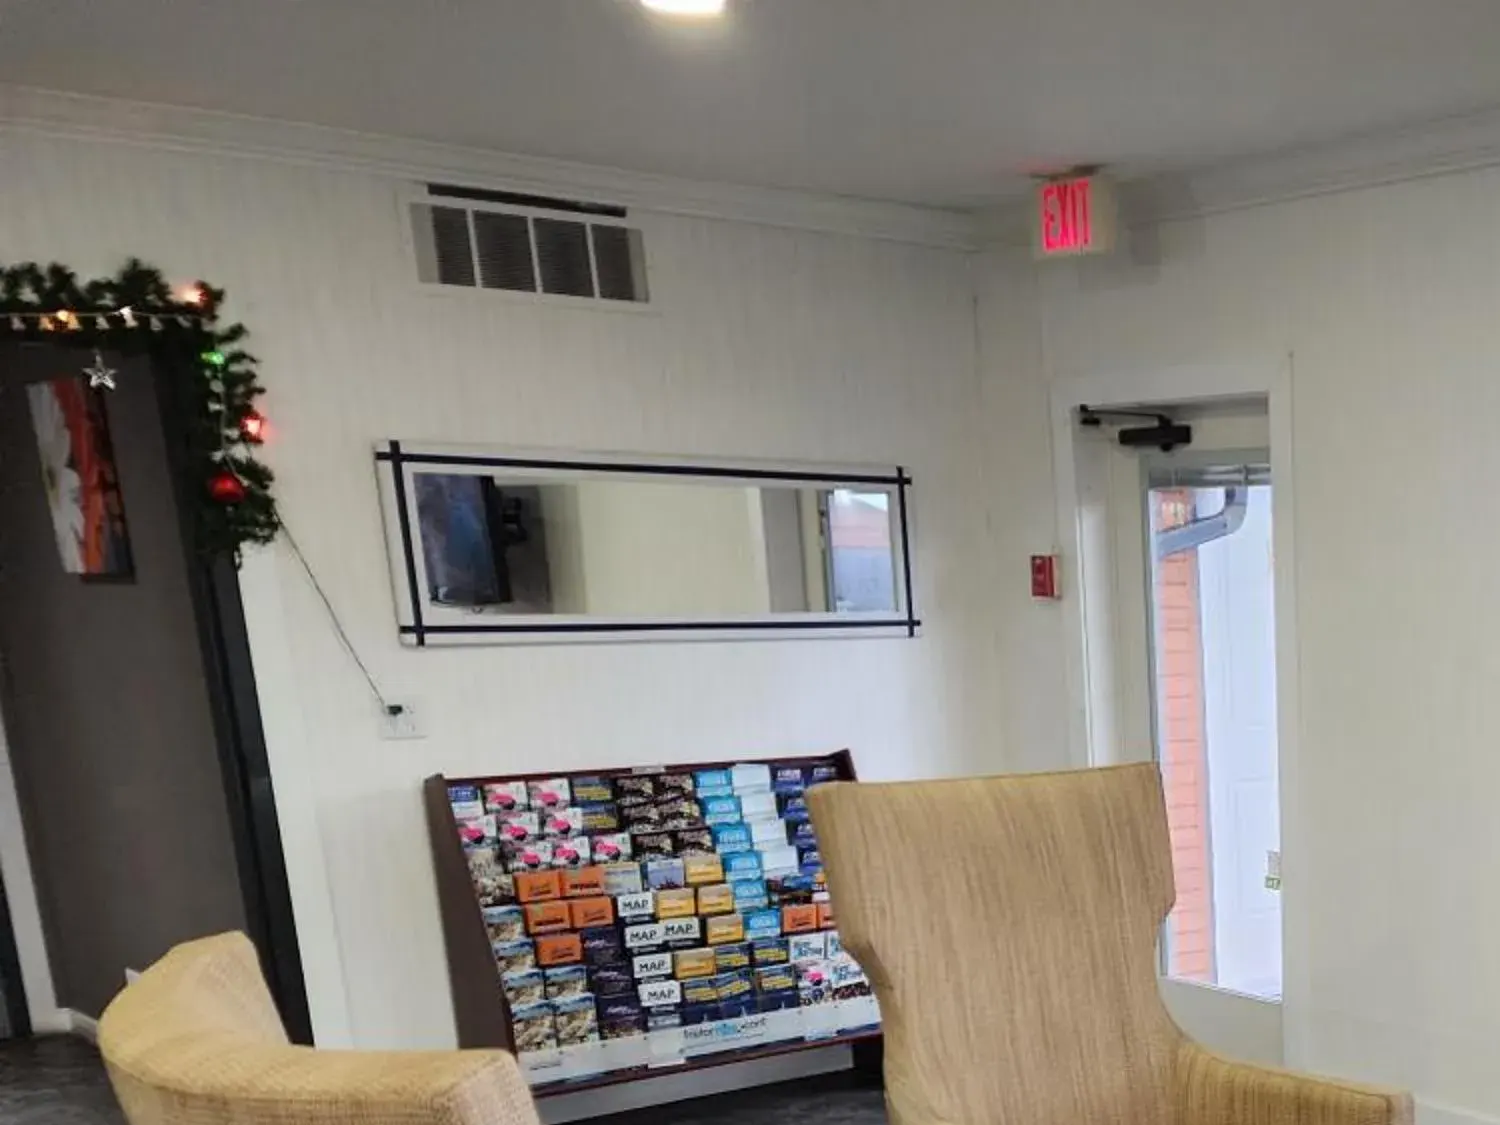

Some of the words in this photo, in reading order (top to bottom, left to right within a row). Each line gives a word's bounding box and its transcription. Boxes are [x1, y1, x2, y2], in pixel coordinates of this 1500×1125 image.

[623, 899, 649, 912] MAP
[630, 929, 657, 942] MAP
[664, 923, 693, 936] MAP
[640, 960, 665, 973] MAP
[647, 988, 674, 1001] MAP
